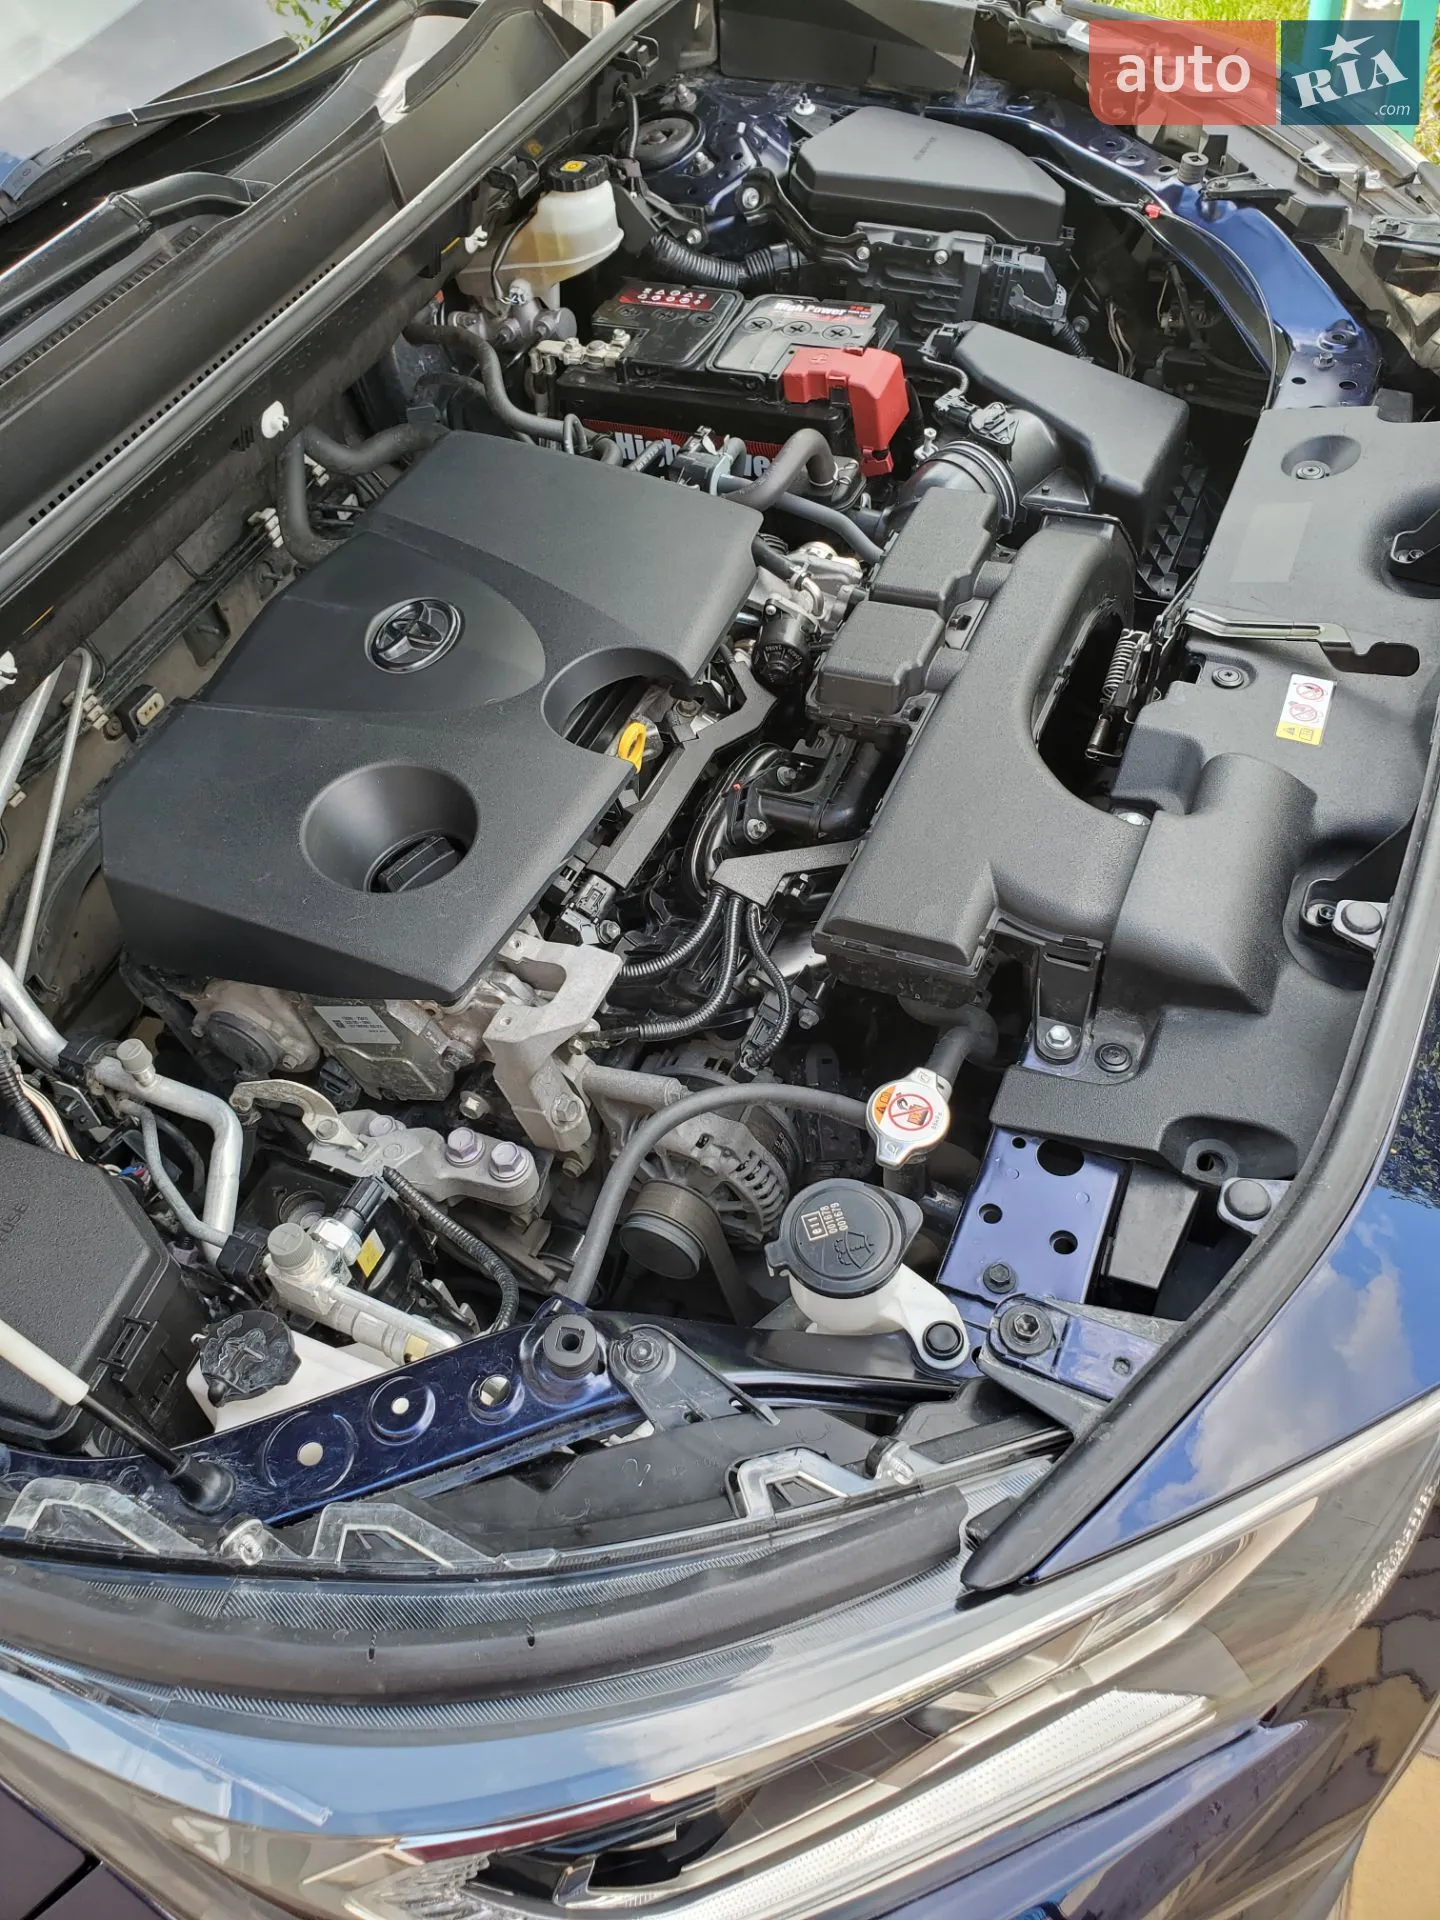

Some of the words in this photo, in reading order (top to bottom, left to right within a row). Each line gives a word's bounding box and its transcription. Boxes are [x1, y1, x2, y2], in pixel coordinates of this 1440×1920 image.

[773, 302, 805, 314] High
[804, 305, 848, 316] Power
[615, 432, 681, 468] Hih
